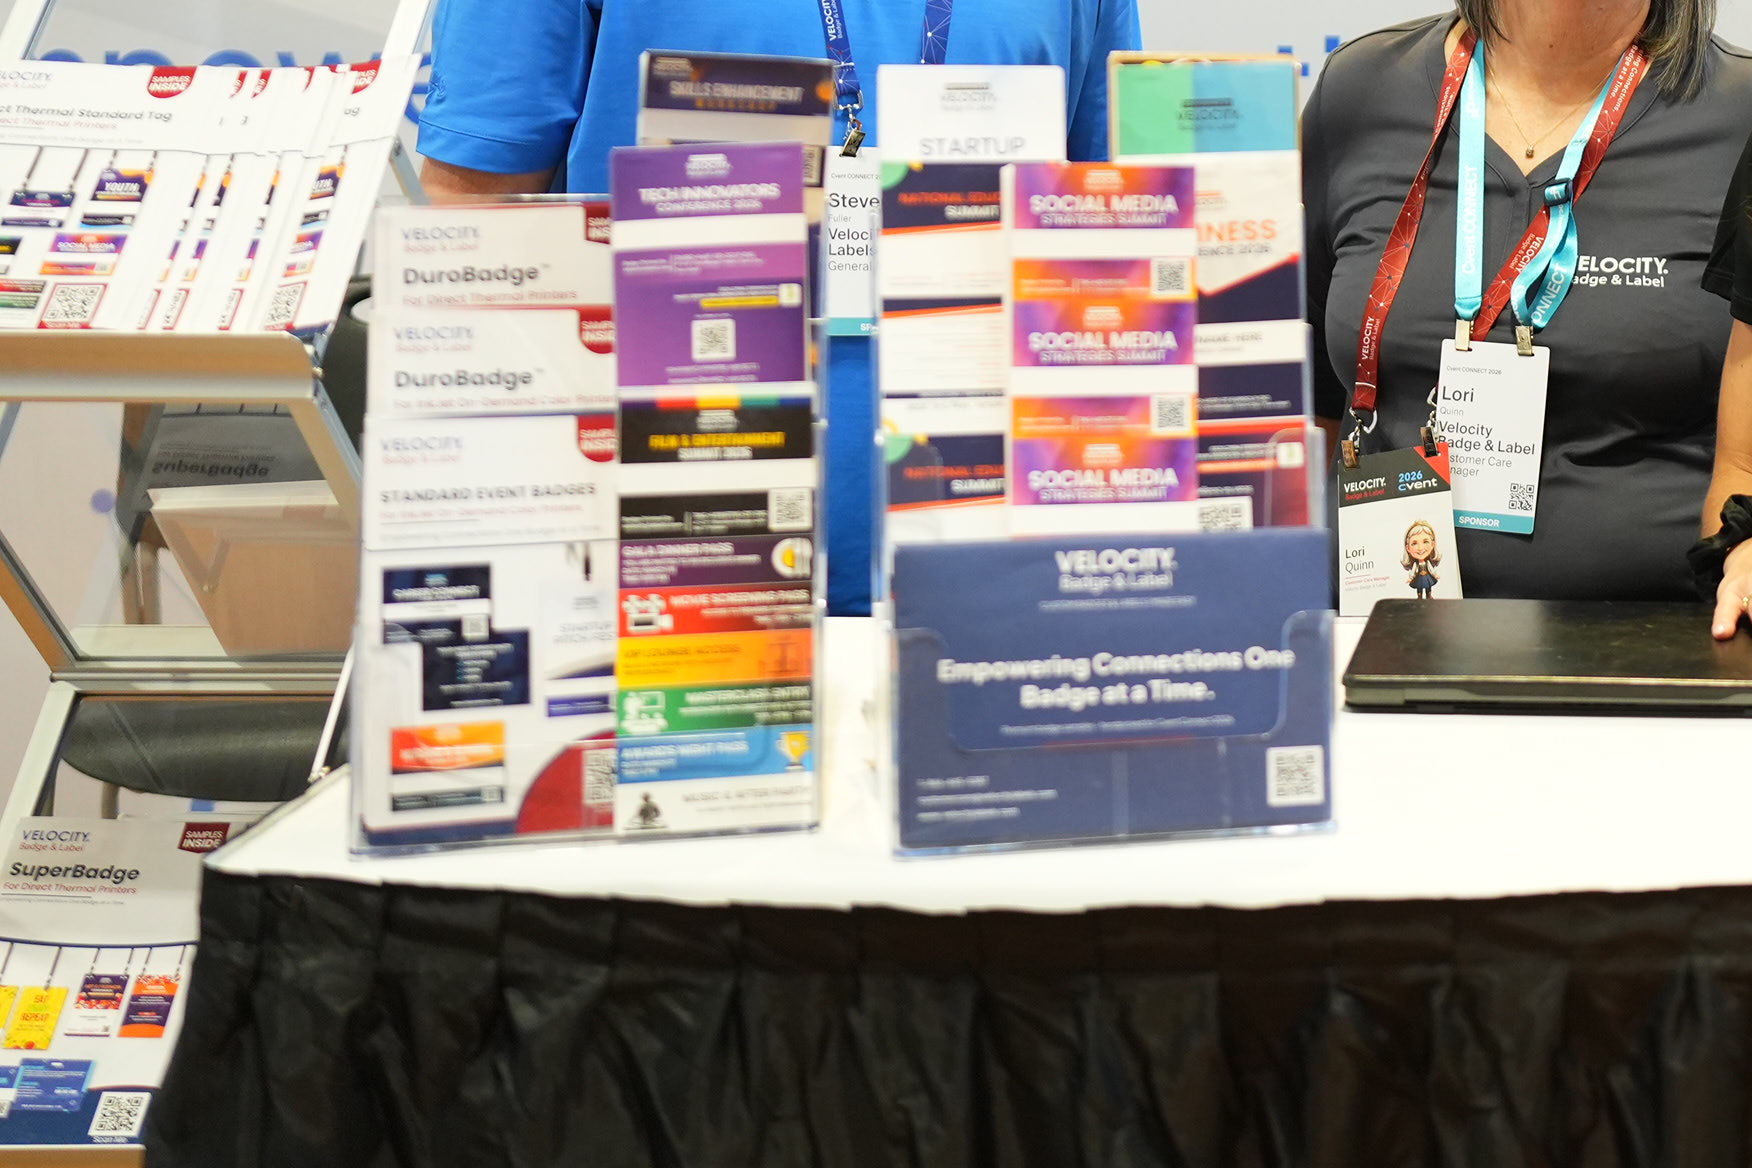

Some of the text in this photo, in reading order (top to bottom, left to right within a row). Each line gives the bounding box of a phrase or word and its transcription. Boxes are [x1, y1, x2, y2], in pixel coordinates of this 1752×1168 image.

[151, 75, 191, 83] SAMPLES
[150, 83, 188, 91] INSIDE
[16, 105, 172, 122] Thermal Standard Tag
[920, 136, 1027, 156] STARTUP
[104, 182, 140, 192] YOUTH
[681, 182, 782, 201] INNOVATORS
[828, 193, 880, 208] Steve
[1029, 194, 1179, 214] SOCIAL MEDIA
[828, 214, 851, 222] Fuller
[1572, 274, 1665, 287] adge & Label
[1028, 331, 1107, 352] SOCIAL
[1110, 331, 1179, 351] MEDIA
[1362, 316, 1374, 360] VELOCITY
[1442, 386, 1474, 402] Lori
[1440, 407, 1464, 416] Quinn
[1439, 420, 1493, 438] Velocity
[1485, 440, 1494, 451] &
[1498, 440, 1535, 454] Label
[1450, 454, 1512, 467] stomer Care
[1027, 468, 1179, 489] SOCIAL MEDIA
[1398, 470, 1423, 483] 2026
[1450, 466, 1479, 477] nager
[381, 482, 596, 503] STANDARD EVENT BADGES
[1459, 516, 1500, 528] SPONSOR
[1345, 546, 1365, 559] Lori
[1345, 560, 1374, 574] Quinn
[1059, 570, 1173, 595] Badge Label
[937, 645, 1296, 686] Empowering Connections One
[1020, 678, 1216, 712] Badge at a Time.
[185, 830, 223, 839] SAMPLES
[19, 842, 84, 852] Badge Label
[183, 838, 221, 848] INSIDE
[10, 862, 140, 884] SuperBadge
[21, 883, 137, 894] Direct Thermal Printers
